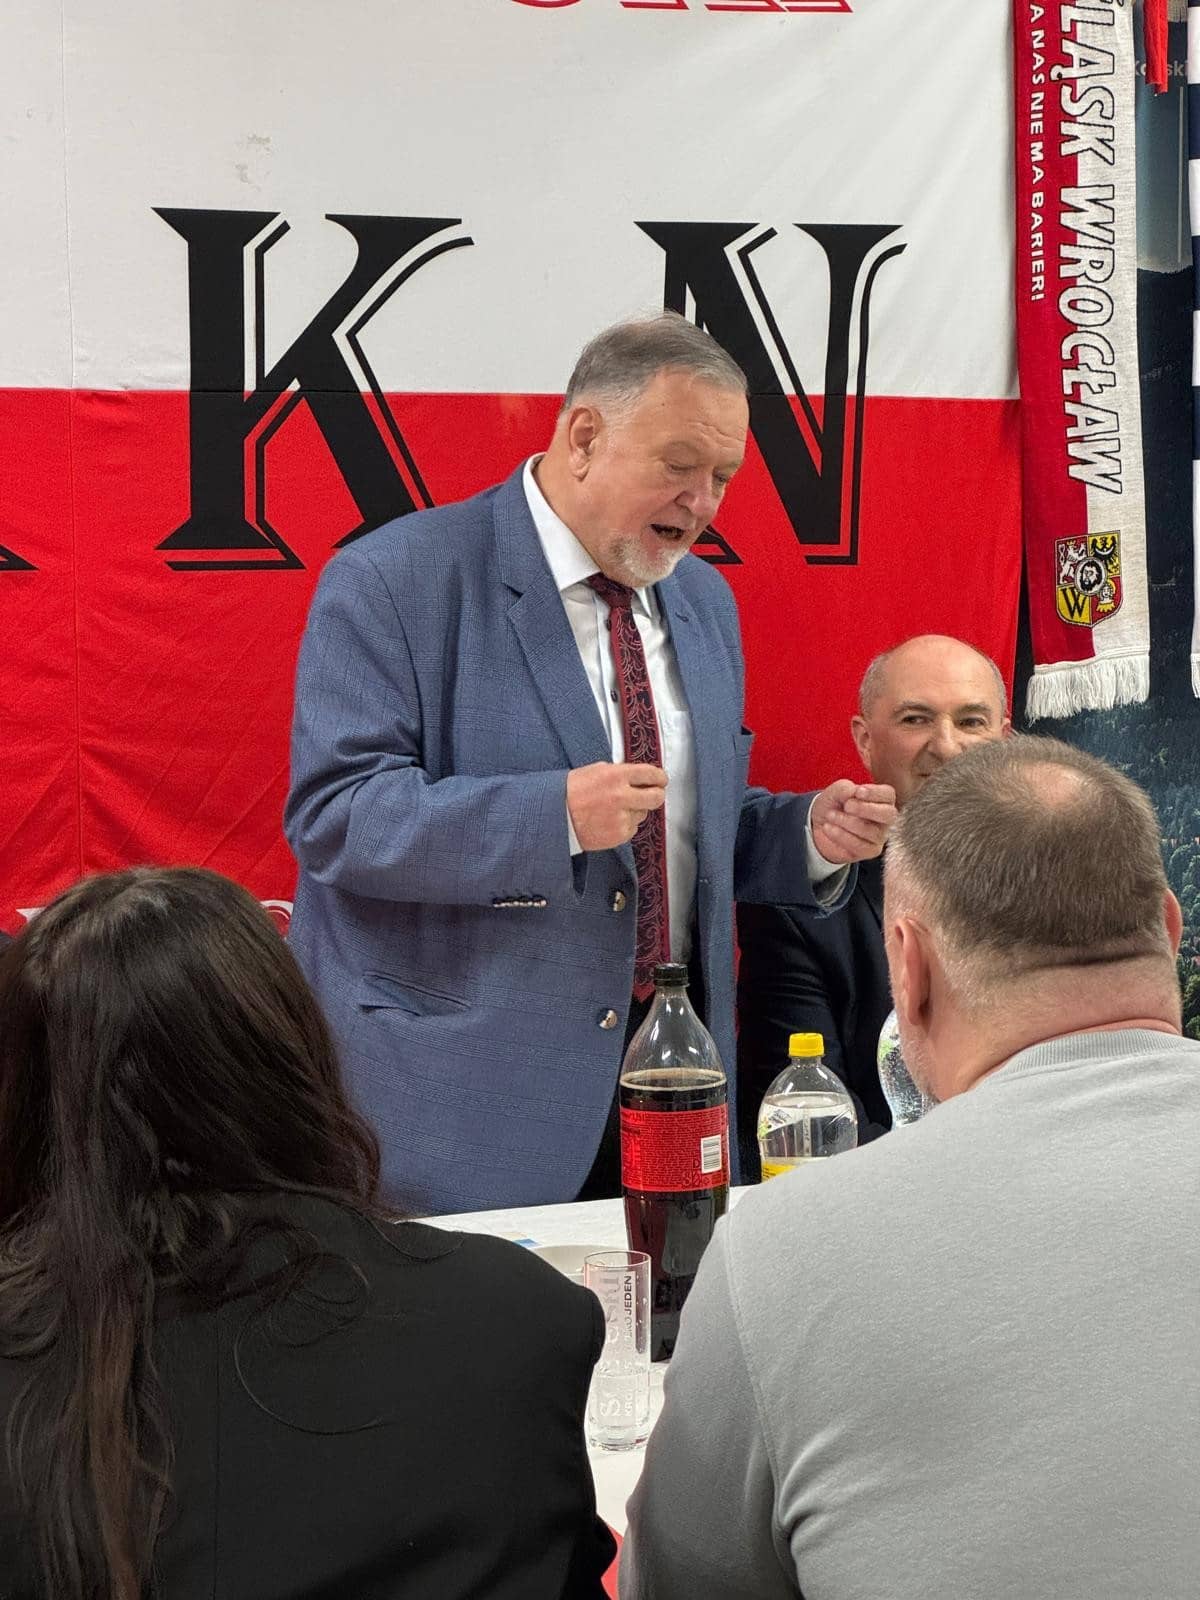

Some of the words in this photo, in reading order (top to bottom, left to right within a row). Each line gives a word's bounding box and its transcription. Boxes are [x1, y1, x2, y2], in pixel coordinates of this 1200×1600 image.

[1030, 30, 1045, 85] NAS
[1050, 0, 1124, 166] LĄSK
[1030, 92, 1045, 135] NIE
[1030, 145, 1045, 185] MA
[1031, 192, 1046, 301] BARIER!
[1058, 184, 1122, 494] WROCŁAW
[623, 1275, 633, 1316] JEDEN
